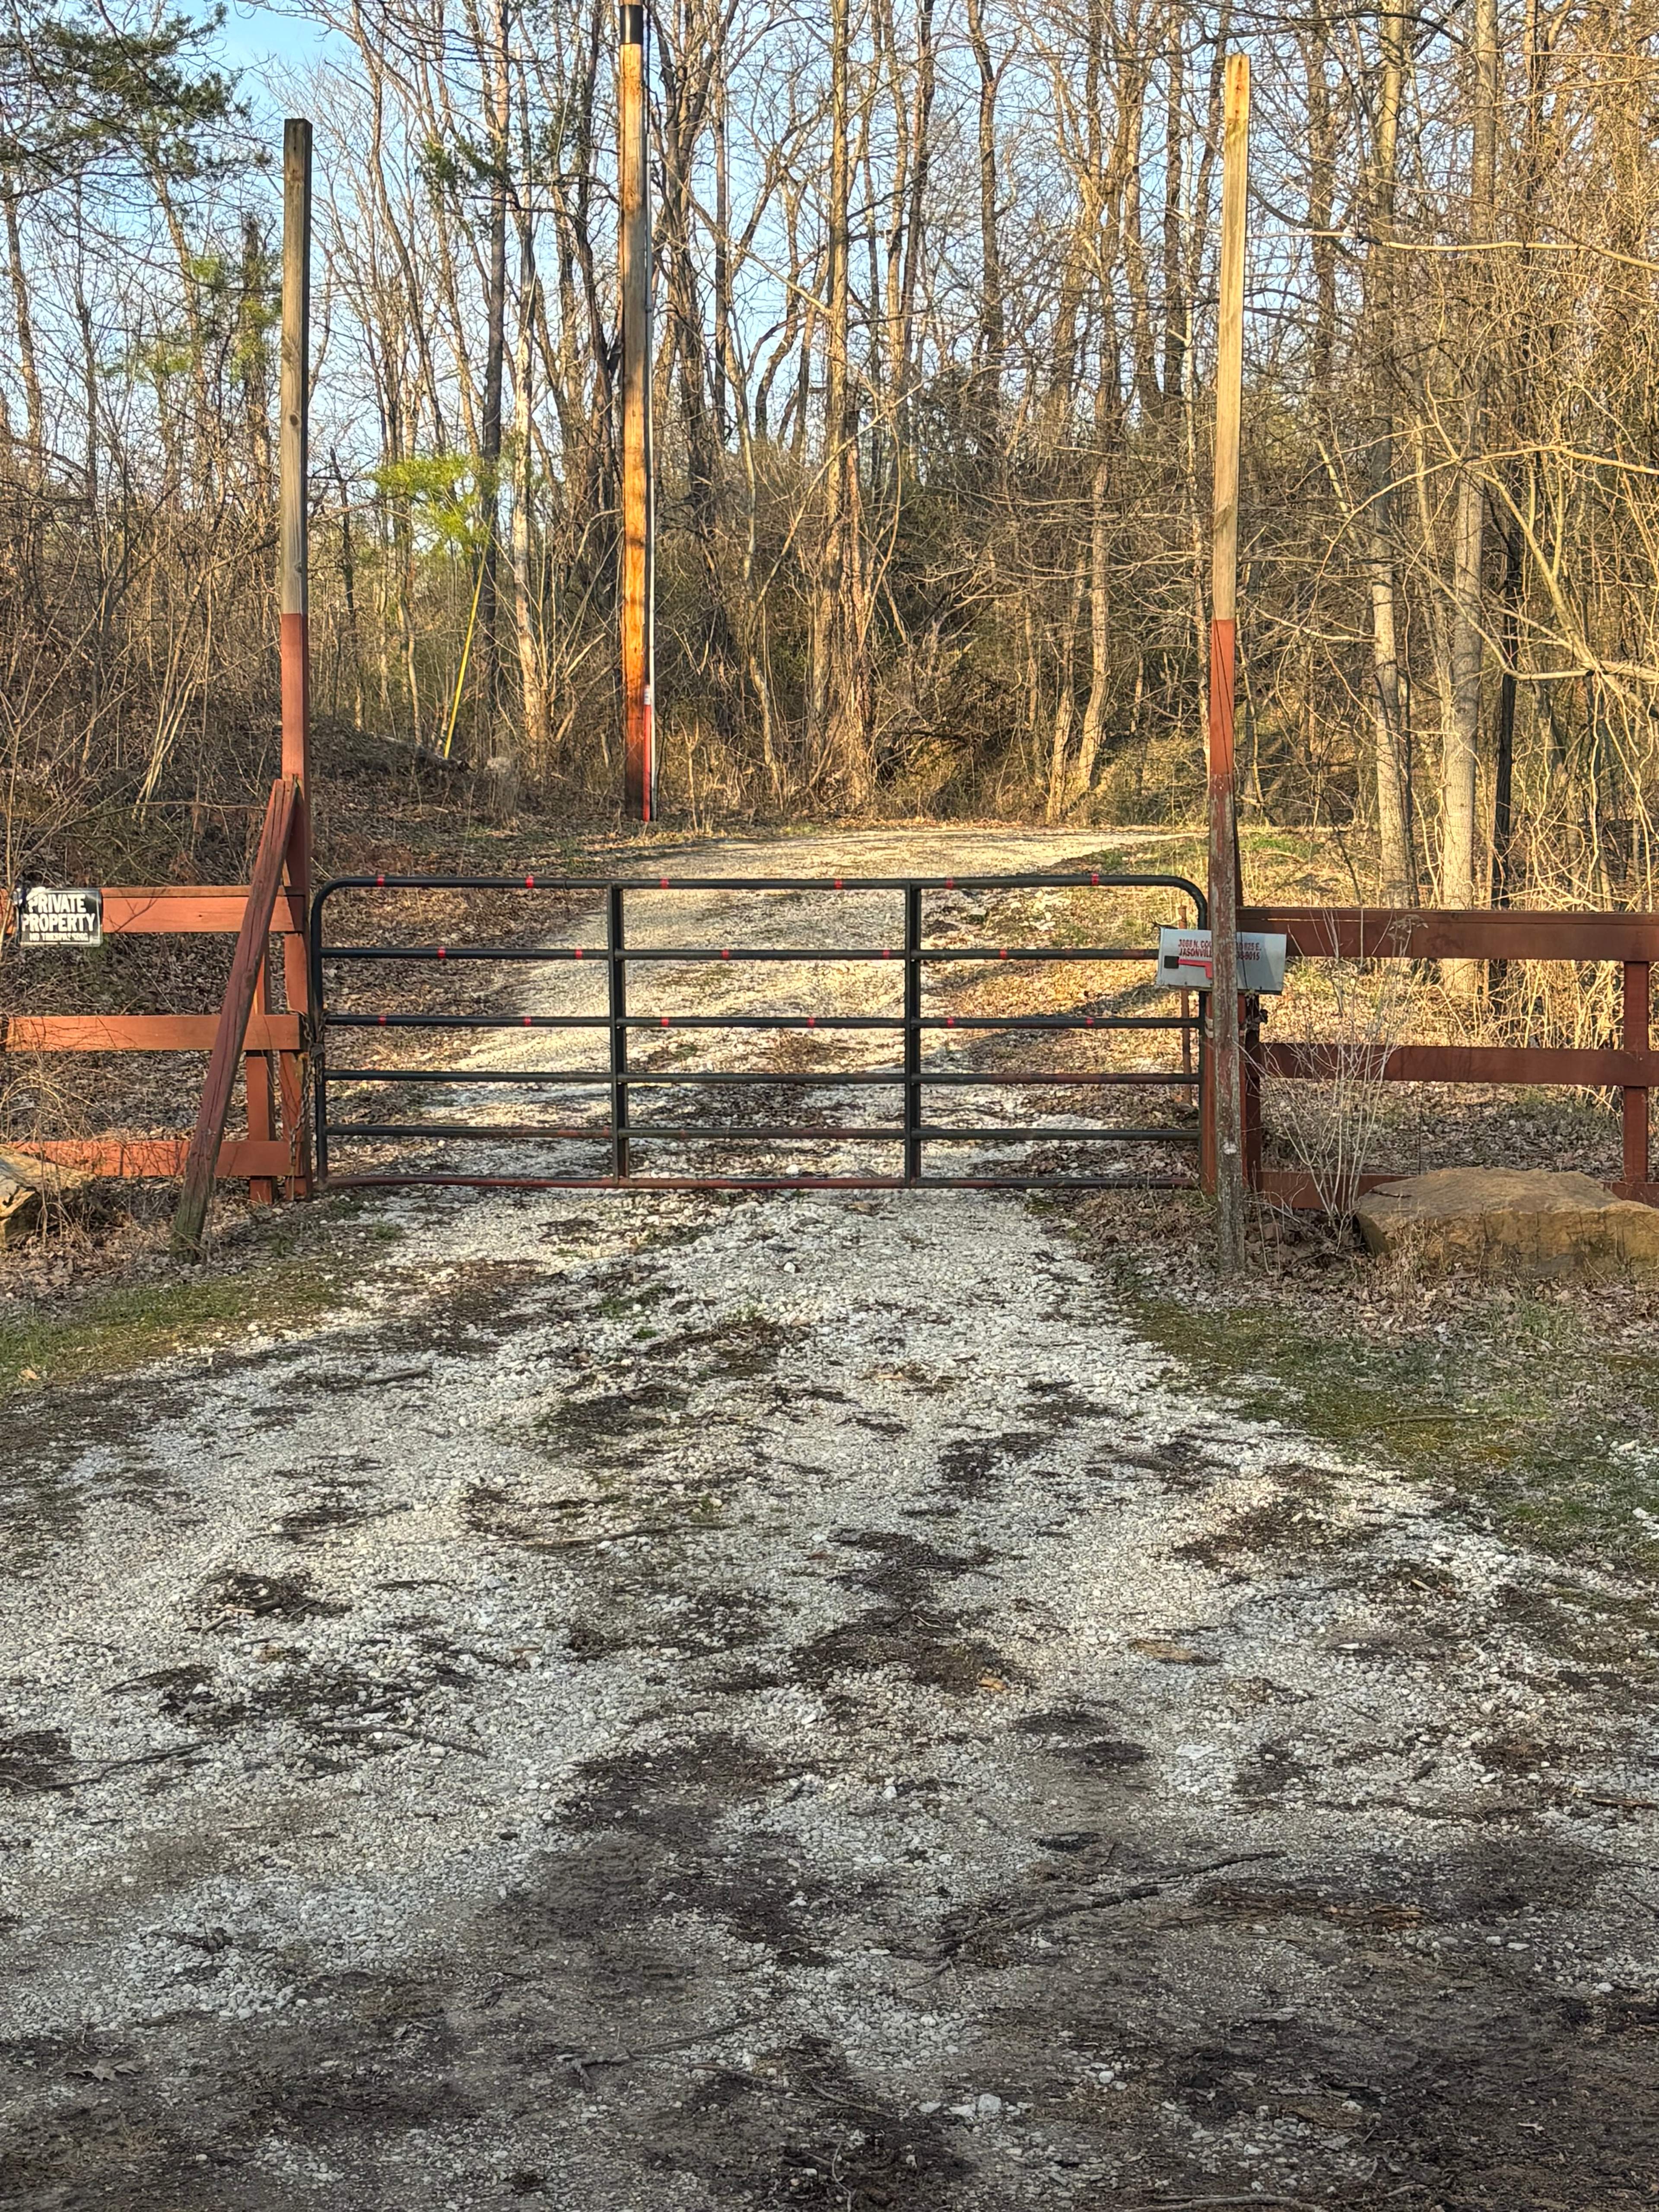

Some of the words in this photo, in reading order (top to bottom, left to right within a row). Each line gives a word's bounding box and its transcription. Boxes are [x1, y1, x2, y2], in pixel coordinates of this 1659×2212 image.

[28, 893, 86, 913] PRIVATE
[22, 913, 95, 932] PROPERTY
[1179, 947, 1213, 958] JASONVILL
